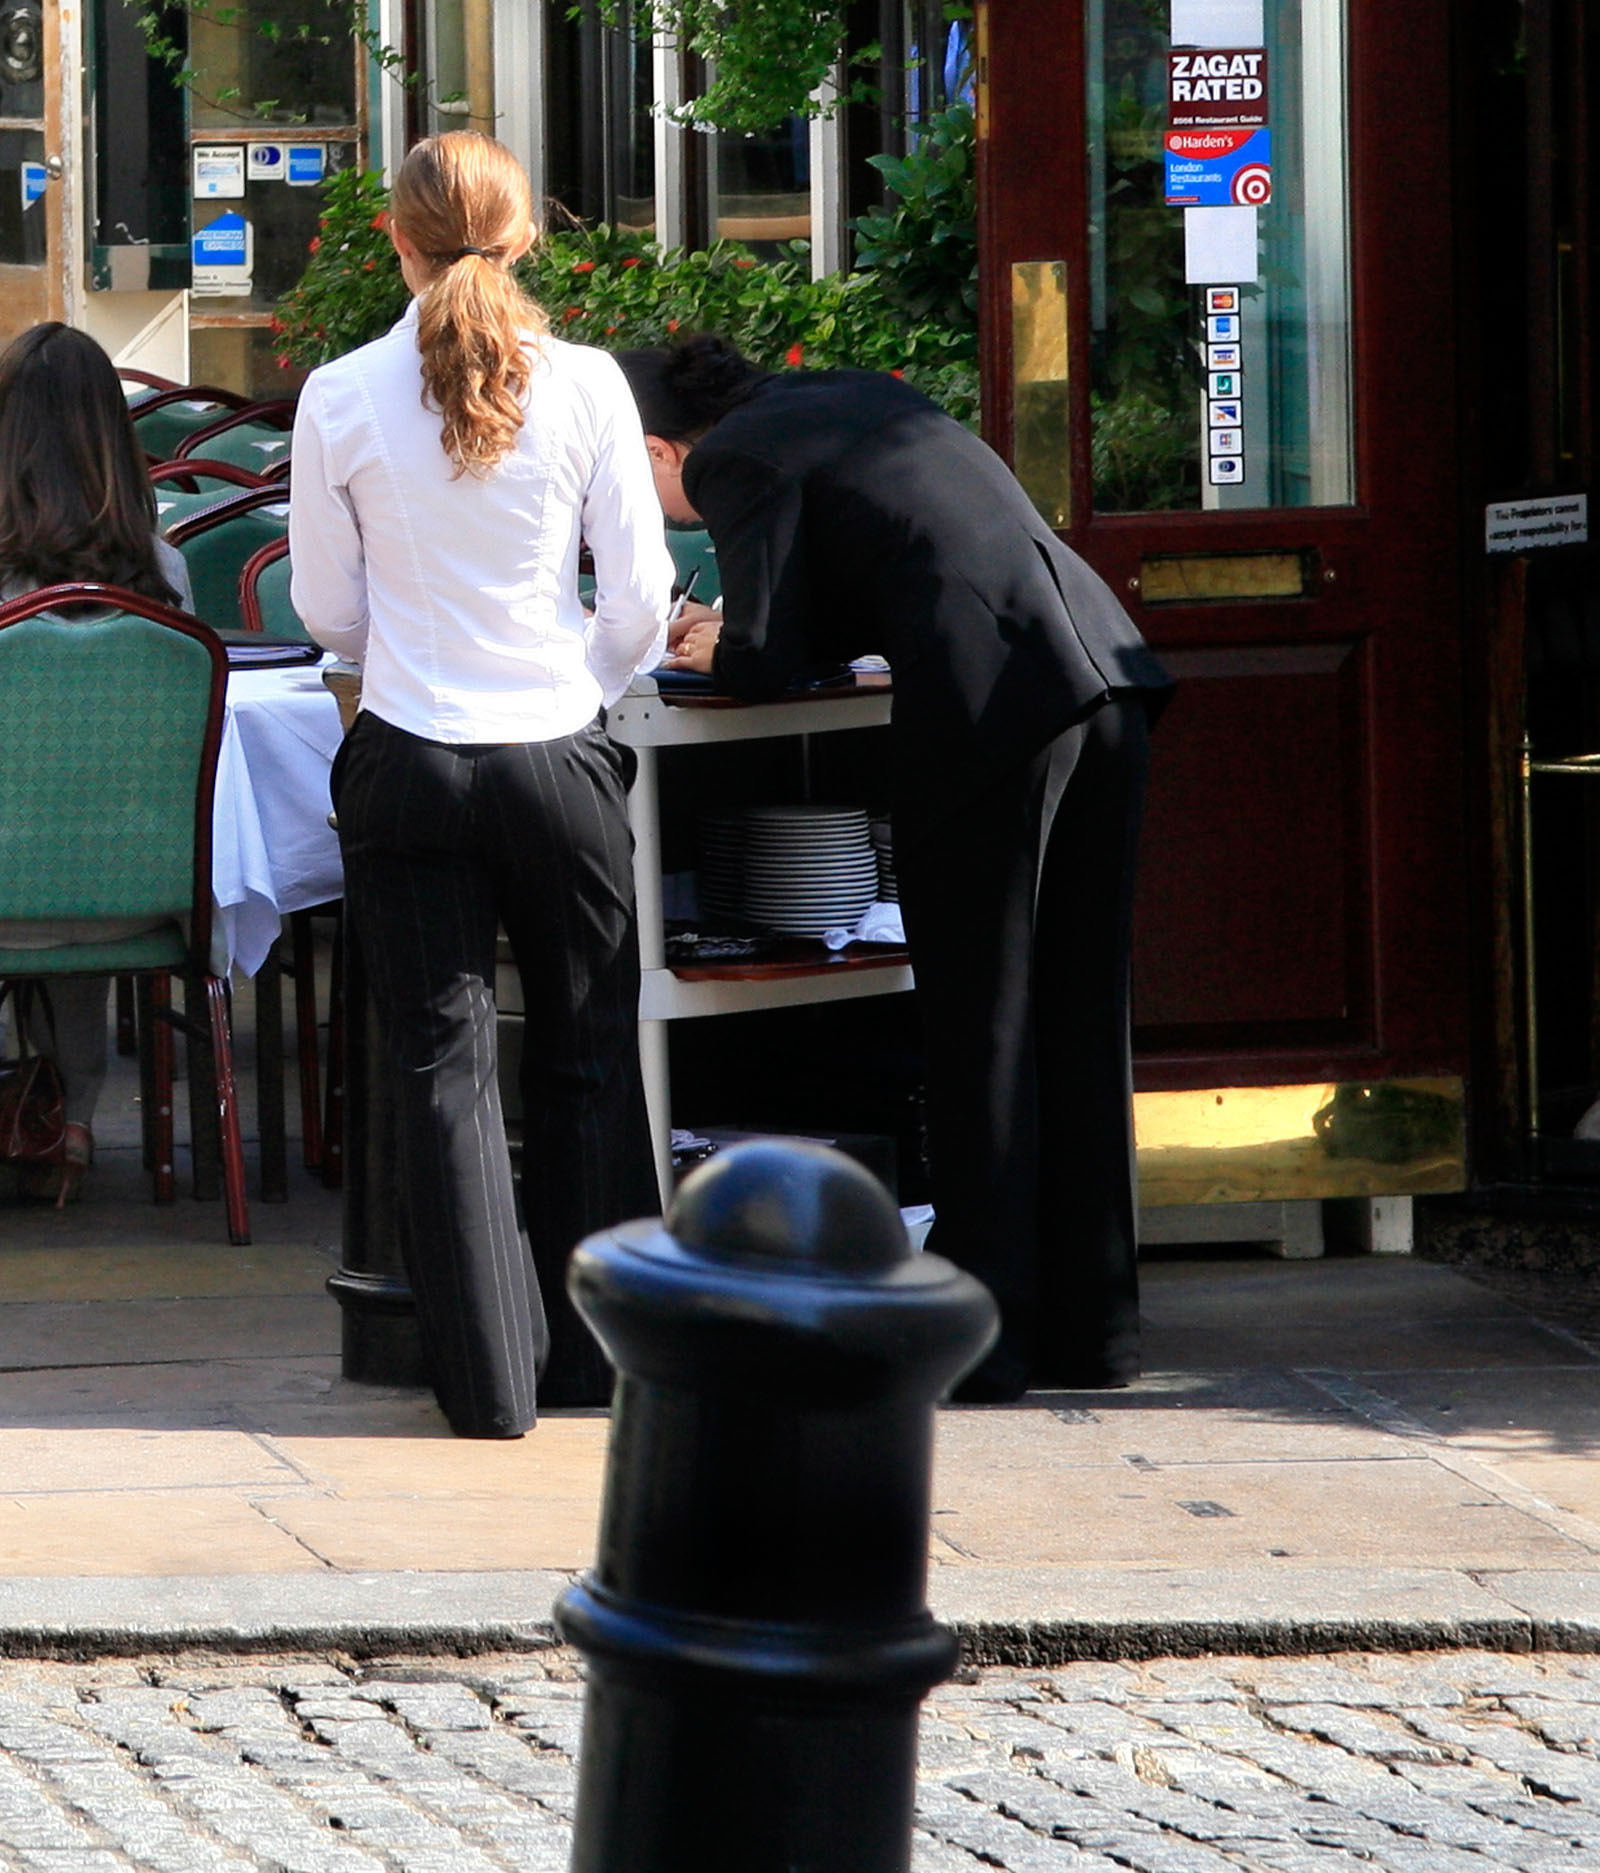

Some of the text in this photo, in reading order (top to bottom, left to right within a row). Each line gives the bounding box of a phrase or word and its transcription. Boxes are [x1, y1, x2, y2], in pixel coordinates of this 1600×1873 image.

[1172, 54, 1263, 78] ZAGAT
[1172, 78, 1263, 102] RATED
[1183, 134, 1234, 148] Harden's
[1170, 162, 1203, 173] London
